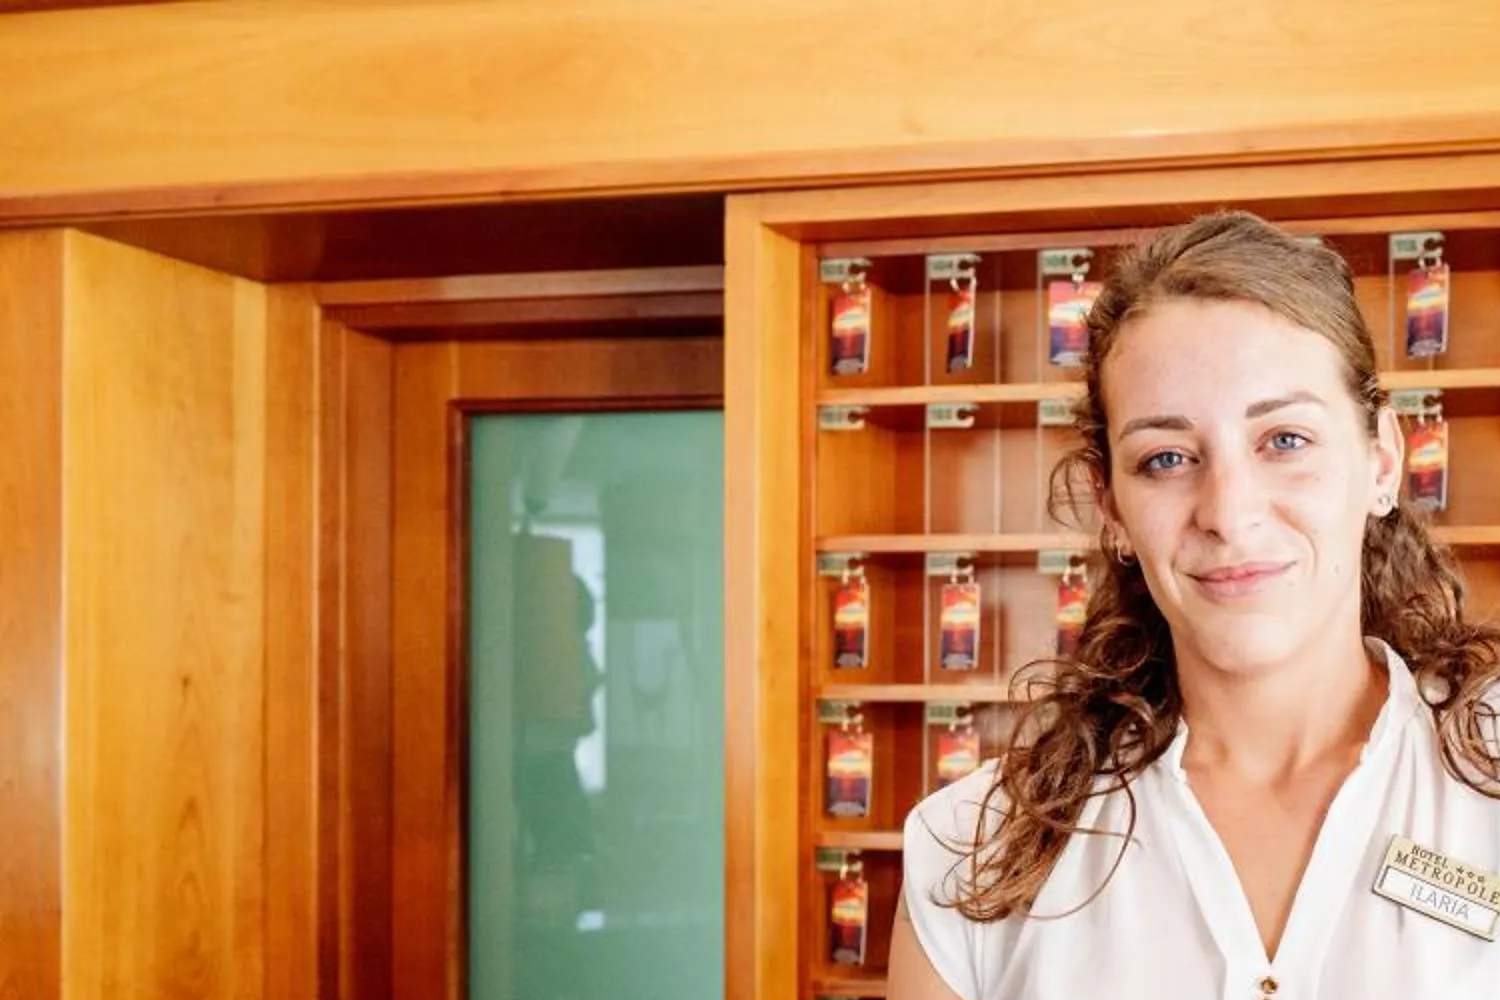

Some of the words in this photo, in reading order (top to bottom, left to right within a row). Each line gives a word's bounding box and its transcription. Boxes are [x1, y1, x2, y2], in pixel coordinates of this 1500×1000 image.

[1410, 844, 1449, 868] HOTEL
[1394, 851, 1500, 905] METROPOLE
[1409, 883, 1470, 920] ILARIA
